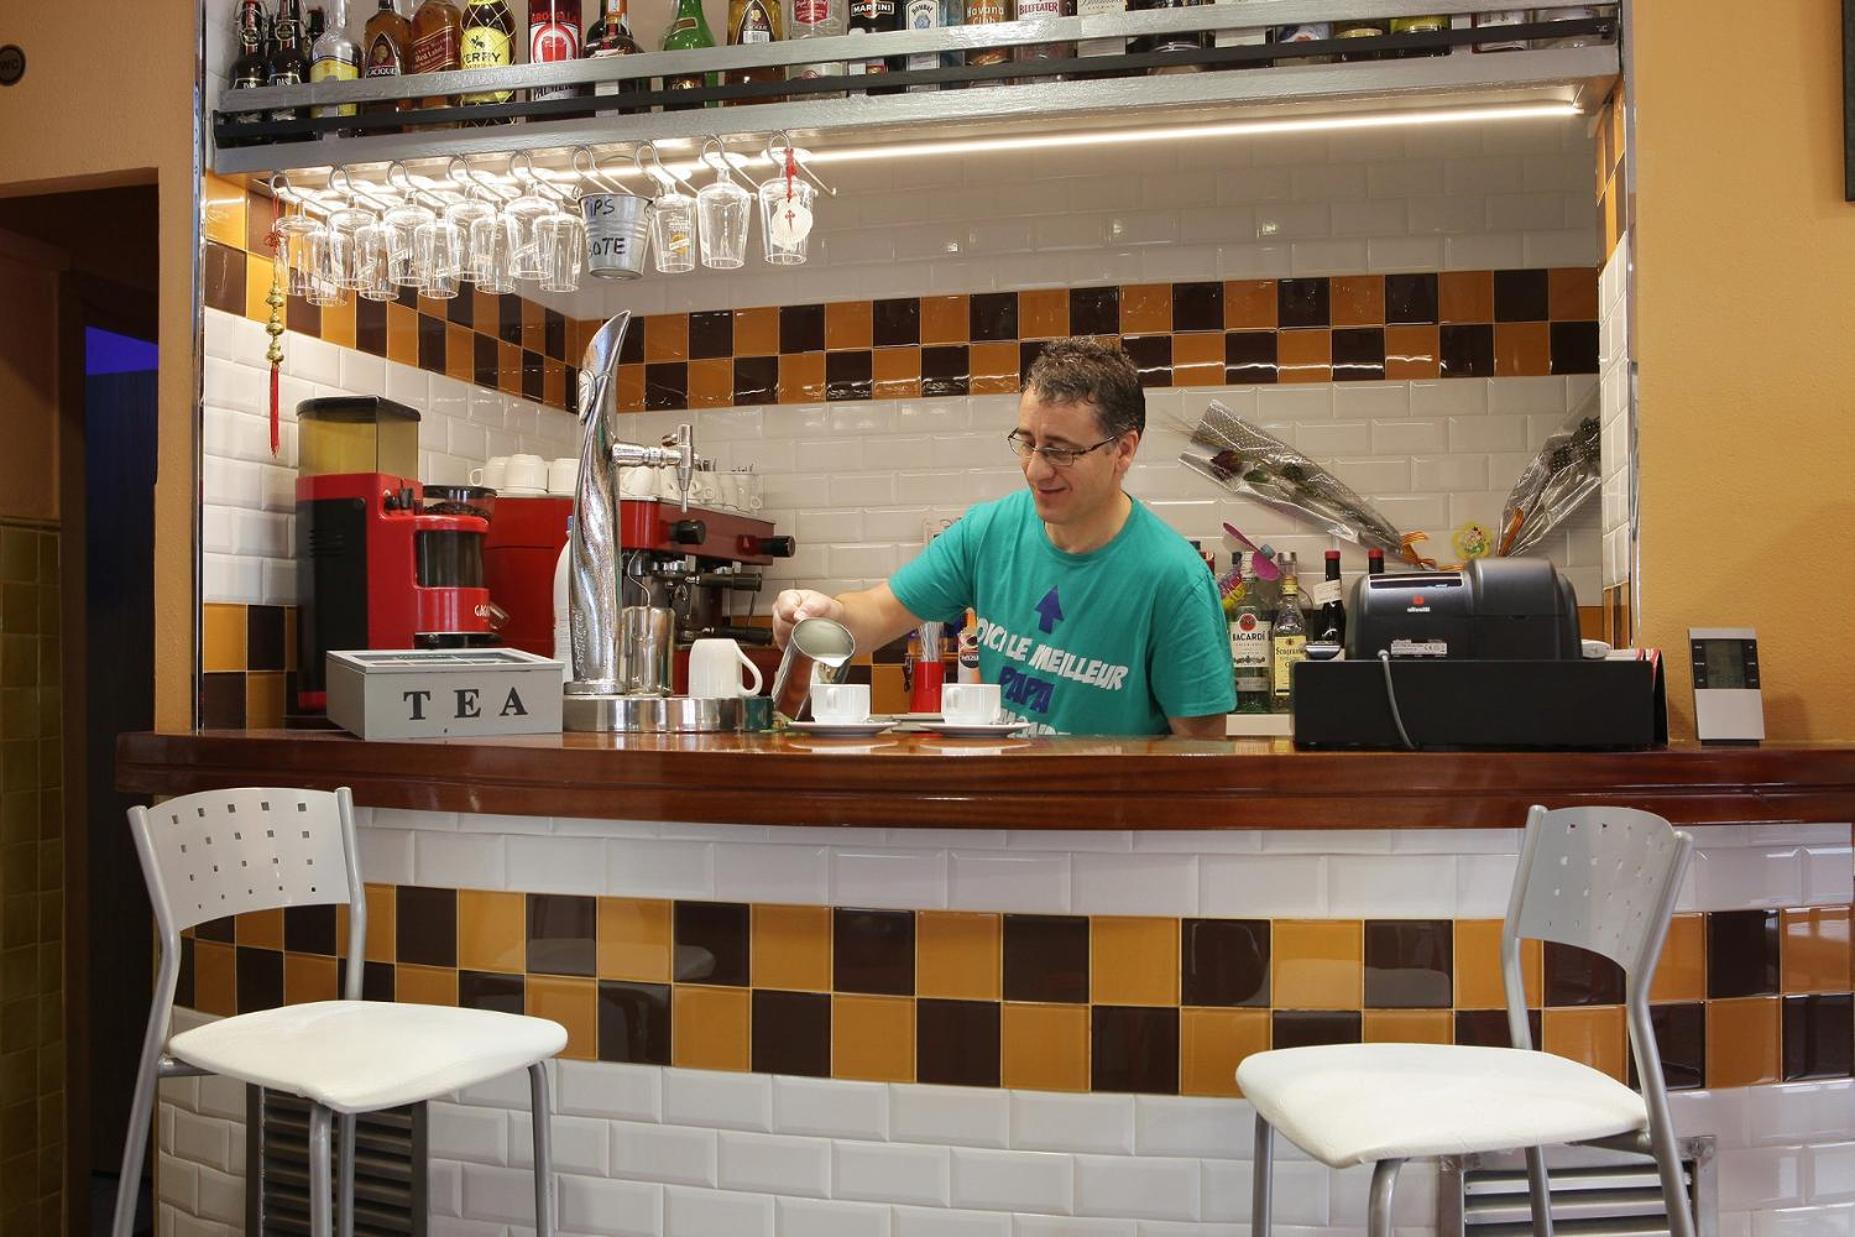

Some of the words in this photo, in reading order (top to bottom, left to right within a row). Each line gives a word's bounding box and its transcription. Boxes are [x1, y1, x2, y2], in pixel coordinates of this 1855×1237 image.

[966, 6, 1004, 17] Havana
[463, 52, 501, 62] ERRY
[589, 237, 626, 256] OTE
[1005, 634, 1033, 662] LE
[1028, 643, 1129, 691] MEILLEUR
[403, 686, 529, 721] TEA
[1000, 665, 1055, 715] PAPA
